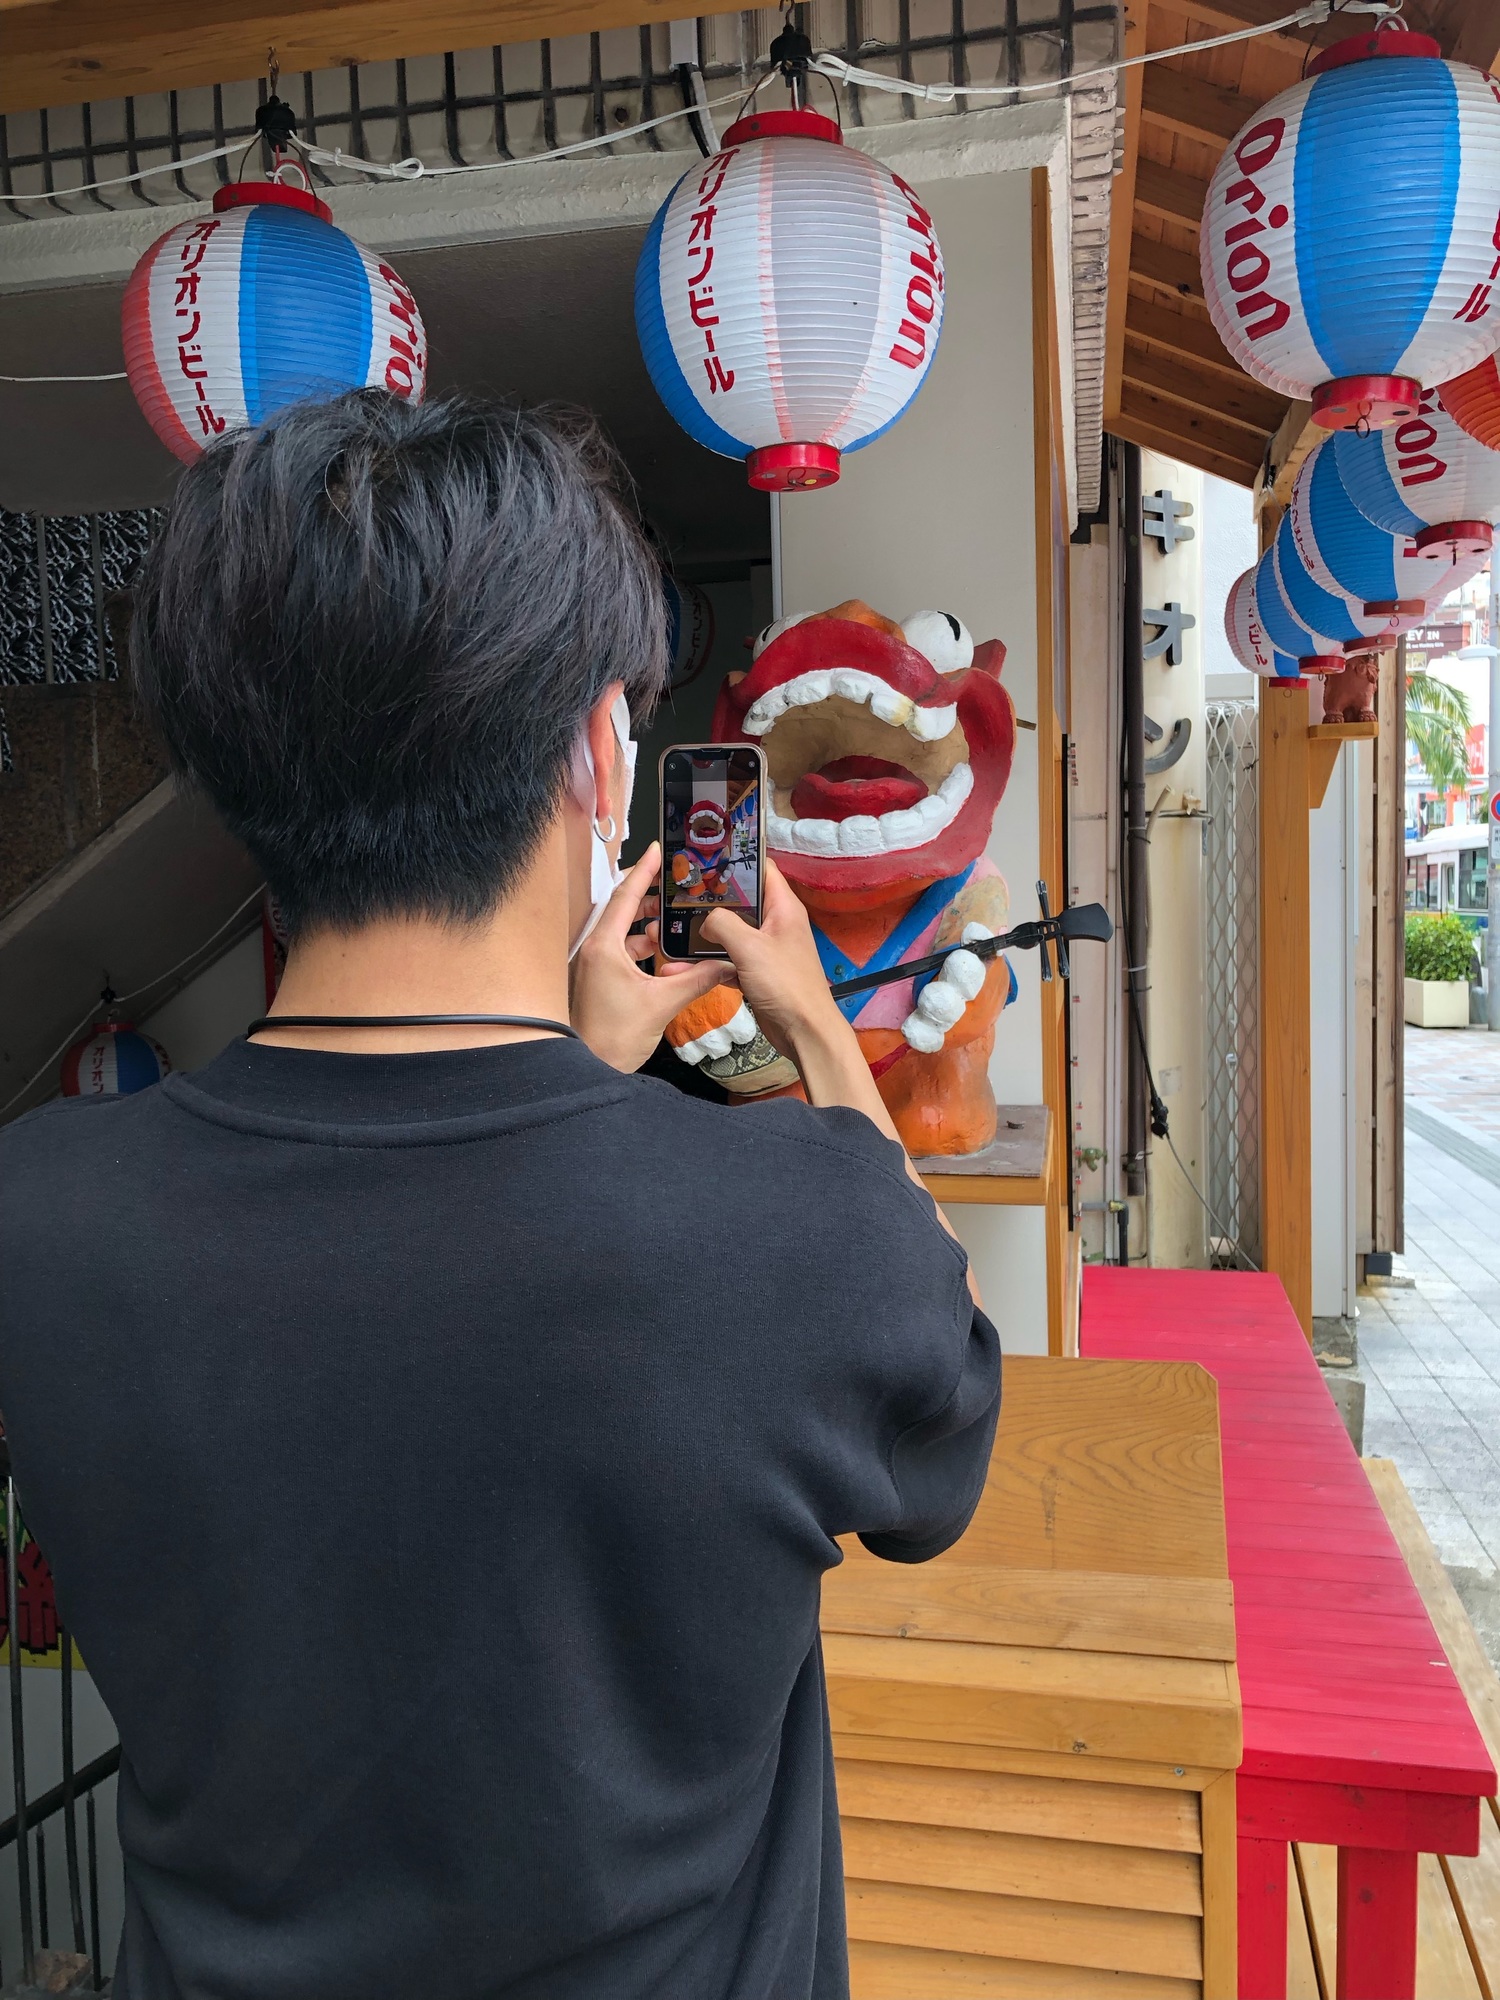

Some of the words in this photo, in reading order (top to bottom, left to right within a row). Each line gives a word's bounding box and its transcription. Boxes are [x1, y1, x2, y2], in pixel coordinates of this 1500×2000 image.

[174, 219, 225, 435] オリオンビール
[687, 148, 740, 395] オリオンビール
[888, 173, 945, 370] Orion
[1224, 117, 1291, 341] Orion
[1405, 629, 1424, 642] EY
